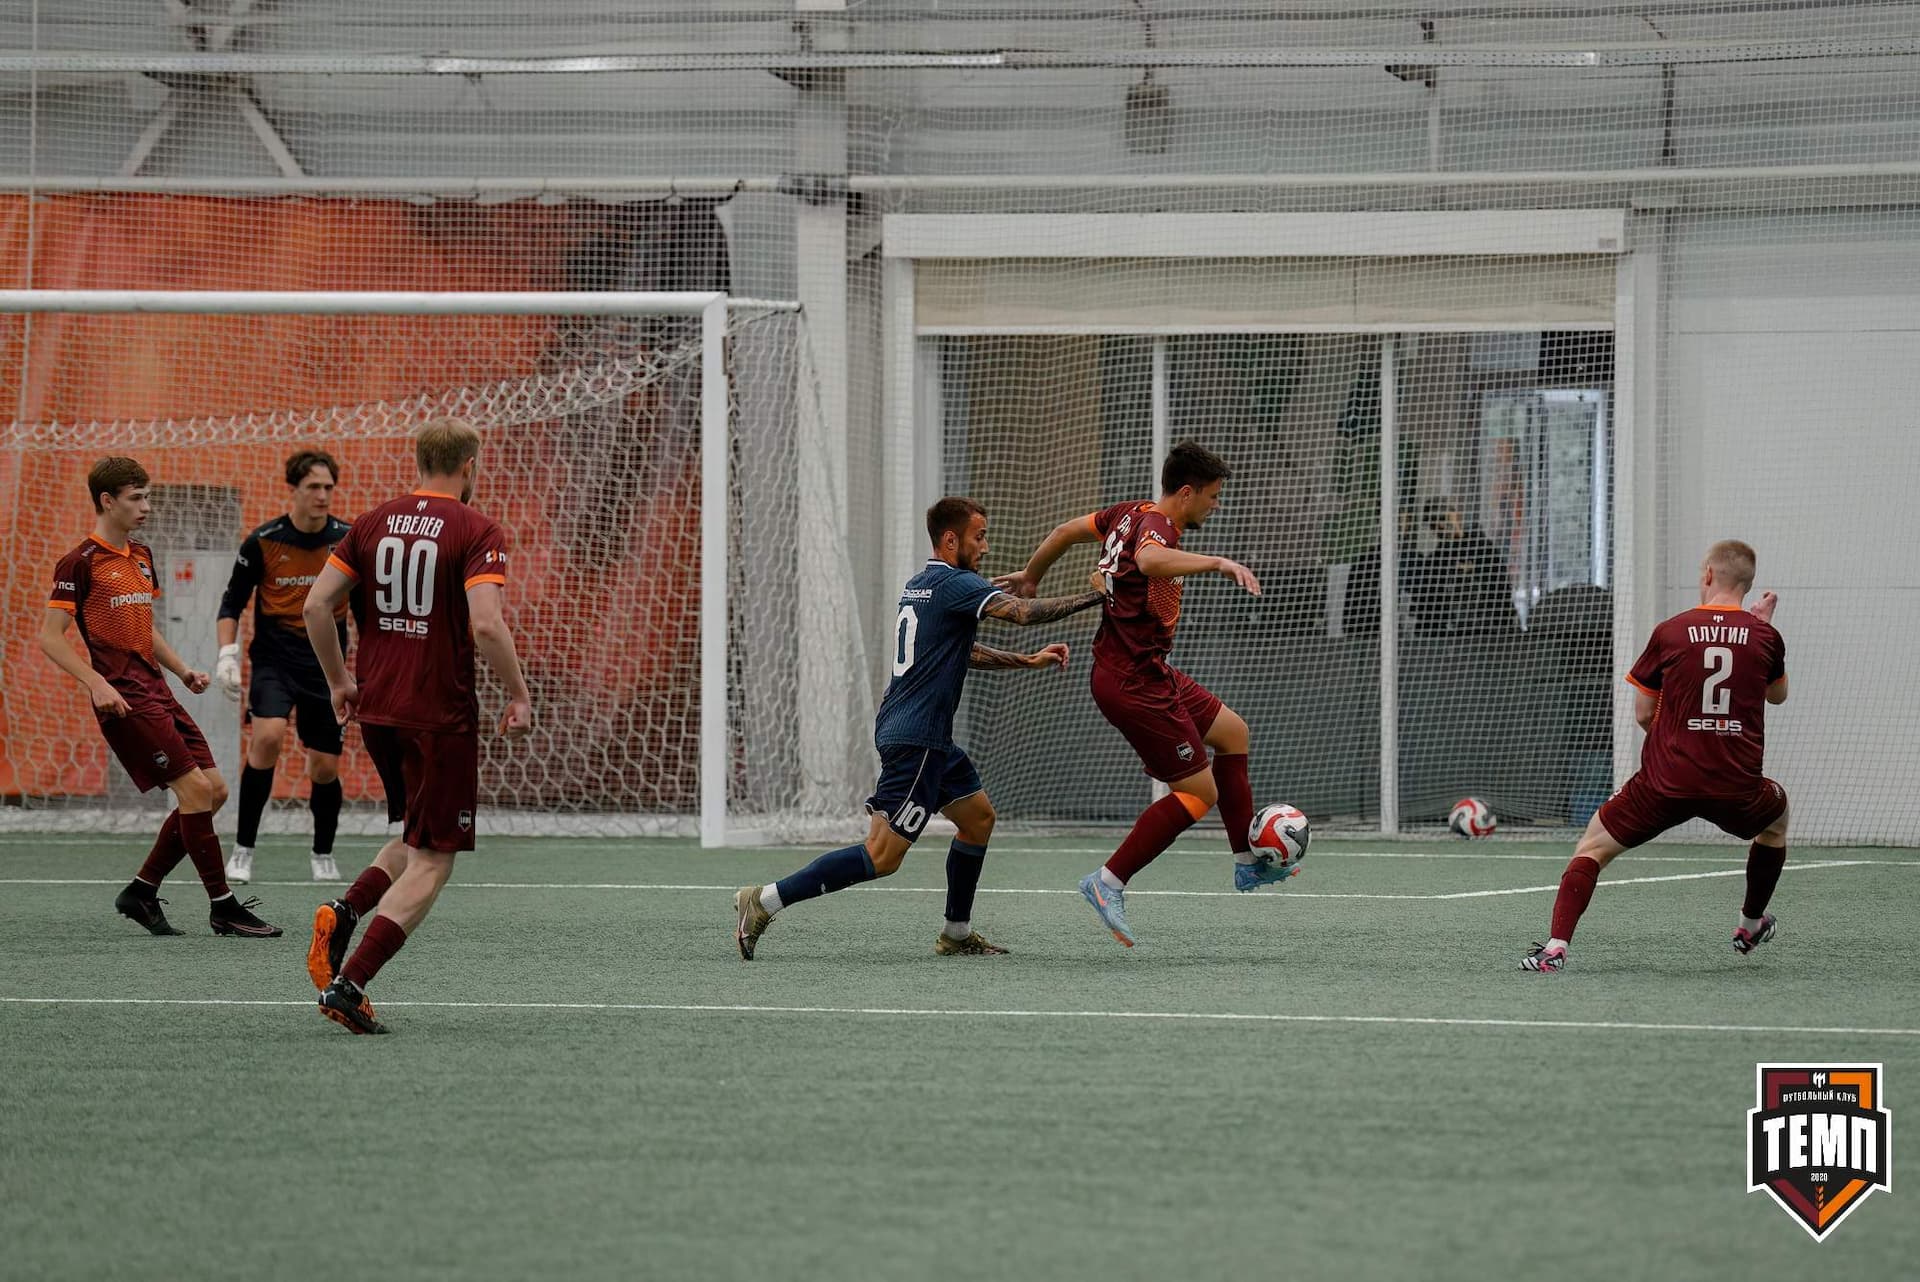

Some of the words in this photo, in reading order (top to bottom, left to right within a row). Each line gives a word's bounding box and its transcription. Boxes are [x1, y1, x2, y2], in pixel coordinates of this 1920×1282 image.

[387, 514, 444, 538] ЧЕВЕЛЕВ
[375, 536, 438, 617] 90
[379, 617, 429, 634] SEUS
[1688, 626, 1749, 645] ПЛУГИН
[1702, 646, 1733, 715] 2
[1687, 718, 1742, 732] SEUS
[895, 800, 926, 833] 10
